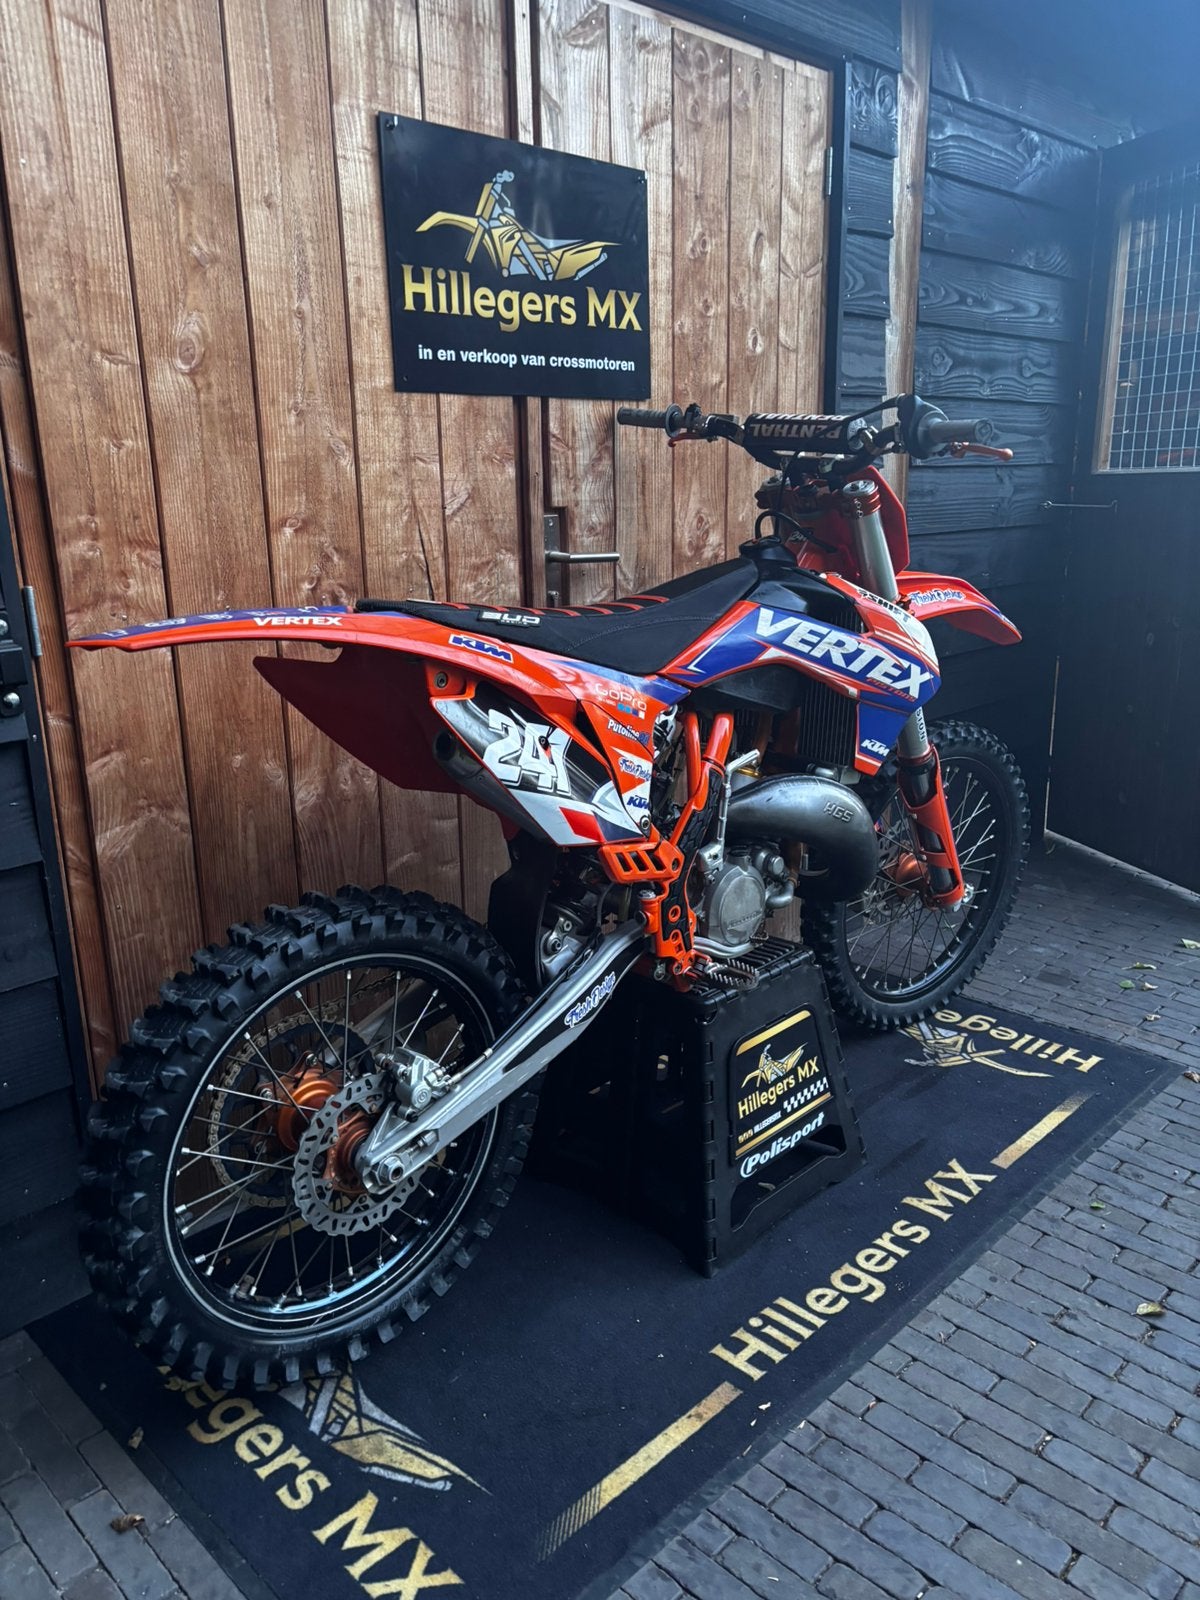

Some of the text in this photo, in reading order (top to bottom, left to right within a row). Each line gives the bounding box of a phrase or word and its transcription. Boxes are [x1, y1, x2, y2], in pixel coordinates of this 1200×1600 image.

[402, 264, 643, 332] Hillegers MX
[418, 344, 635, 372] in en verkoop van crossmotoren
[252, 616, 343, 627] VERTEX
[452, 635, 513, 662] KTM
[755, 606, 935, 700] VERTEX
[861, 739, 890, 757] KTM
[823, 801, 854, 823] HGS
[737, 1055, 820, 1120] Hillegers MX
[740, 1110, 825, 1179] Polisport
[709, 1157, 998, 1383] Hillegers MX
[311, 1489, 466, 1600] MX
